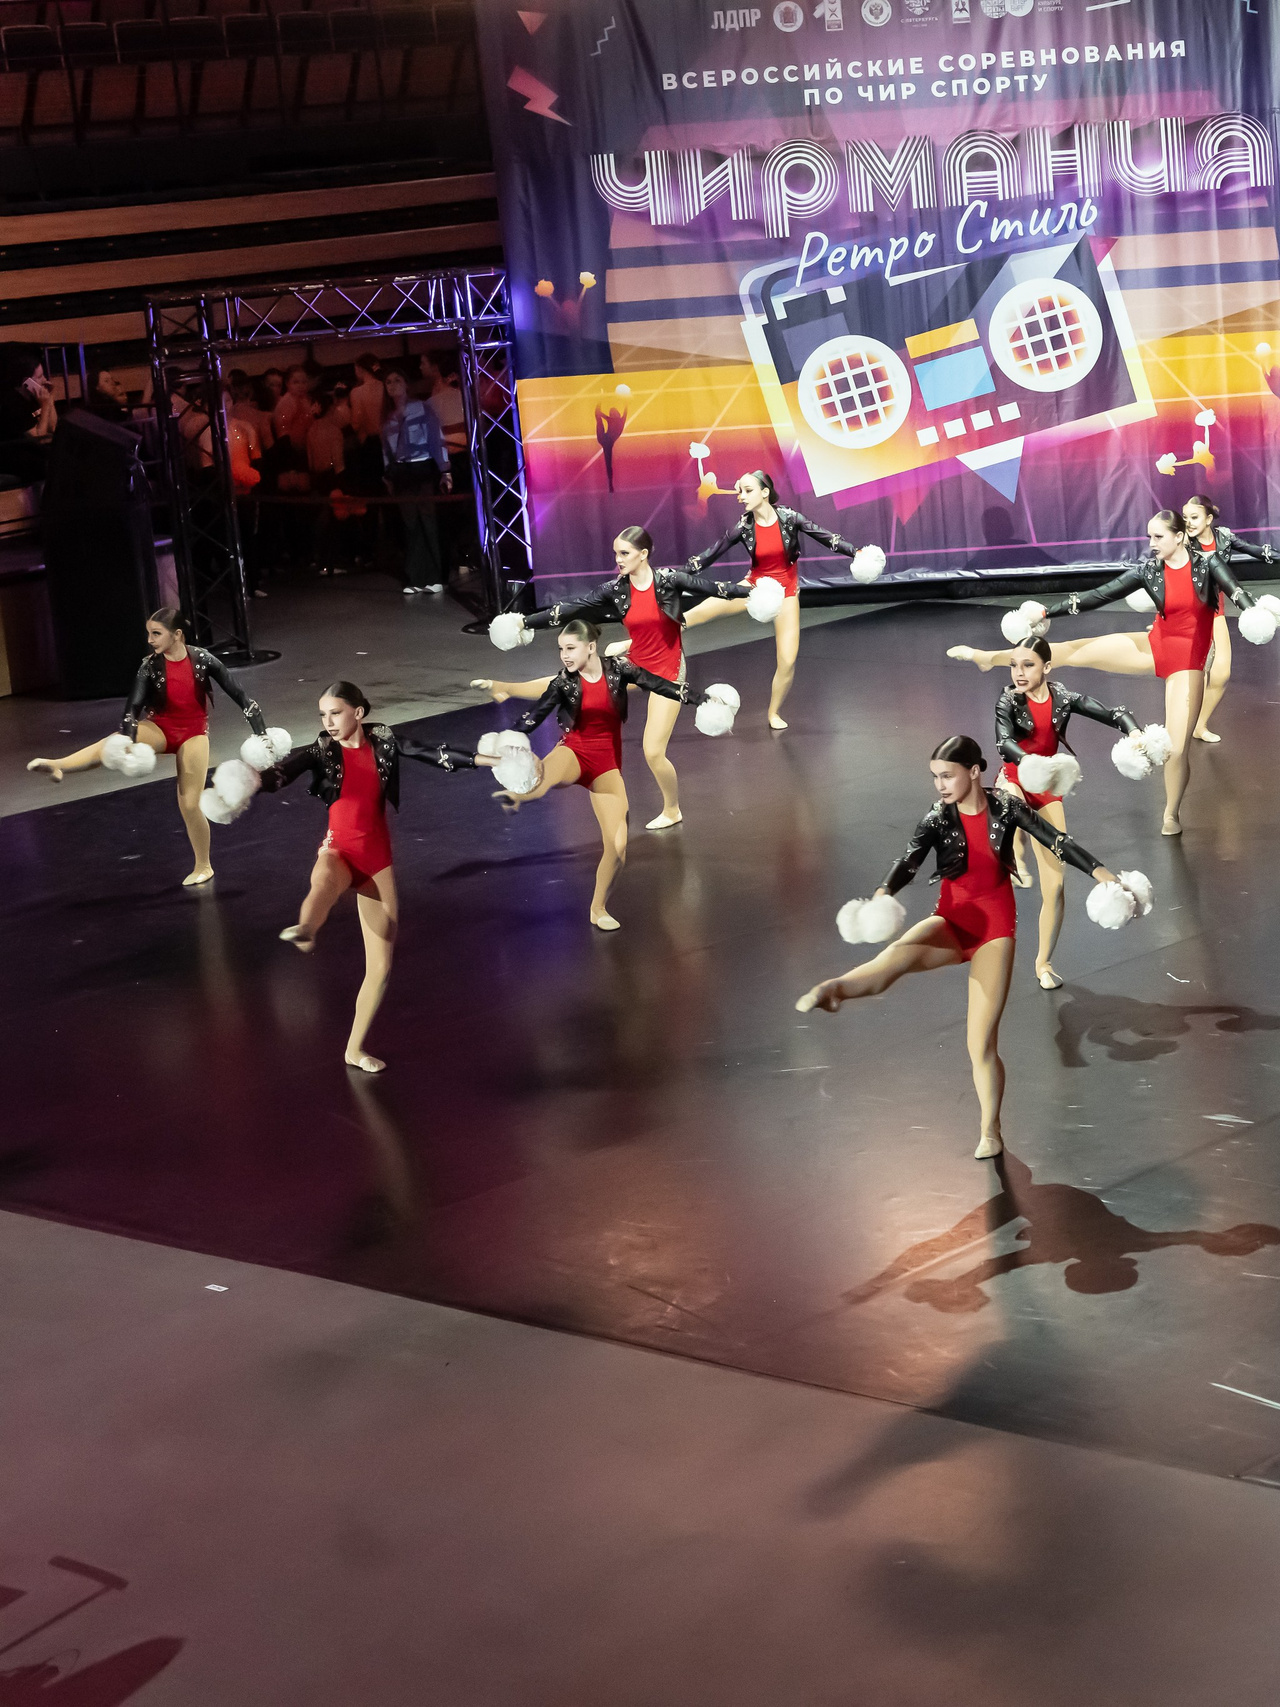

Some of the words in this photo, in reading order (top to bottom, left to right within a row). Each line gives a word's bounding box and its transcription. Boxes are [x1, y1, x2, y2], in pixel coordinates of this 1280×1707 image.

[711, 9, 761, 31] ЛДПР
[662, 57, 924, 90] ВСЕРОССИЙСКИЕ
[938, 40, 1186, 73] СОРЕВНОВАНИЯ
[803, 87, 843, 106] ПО
[857, 82, 916, 101] ЧИР
[931, 73, 1048, 98] СПОРТУ
[795, 231, 936, 287] Ретро
[956, 198, 1098, 254] Стиль
